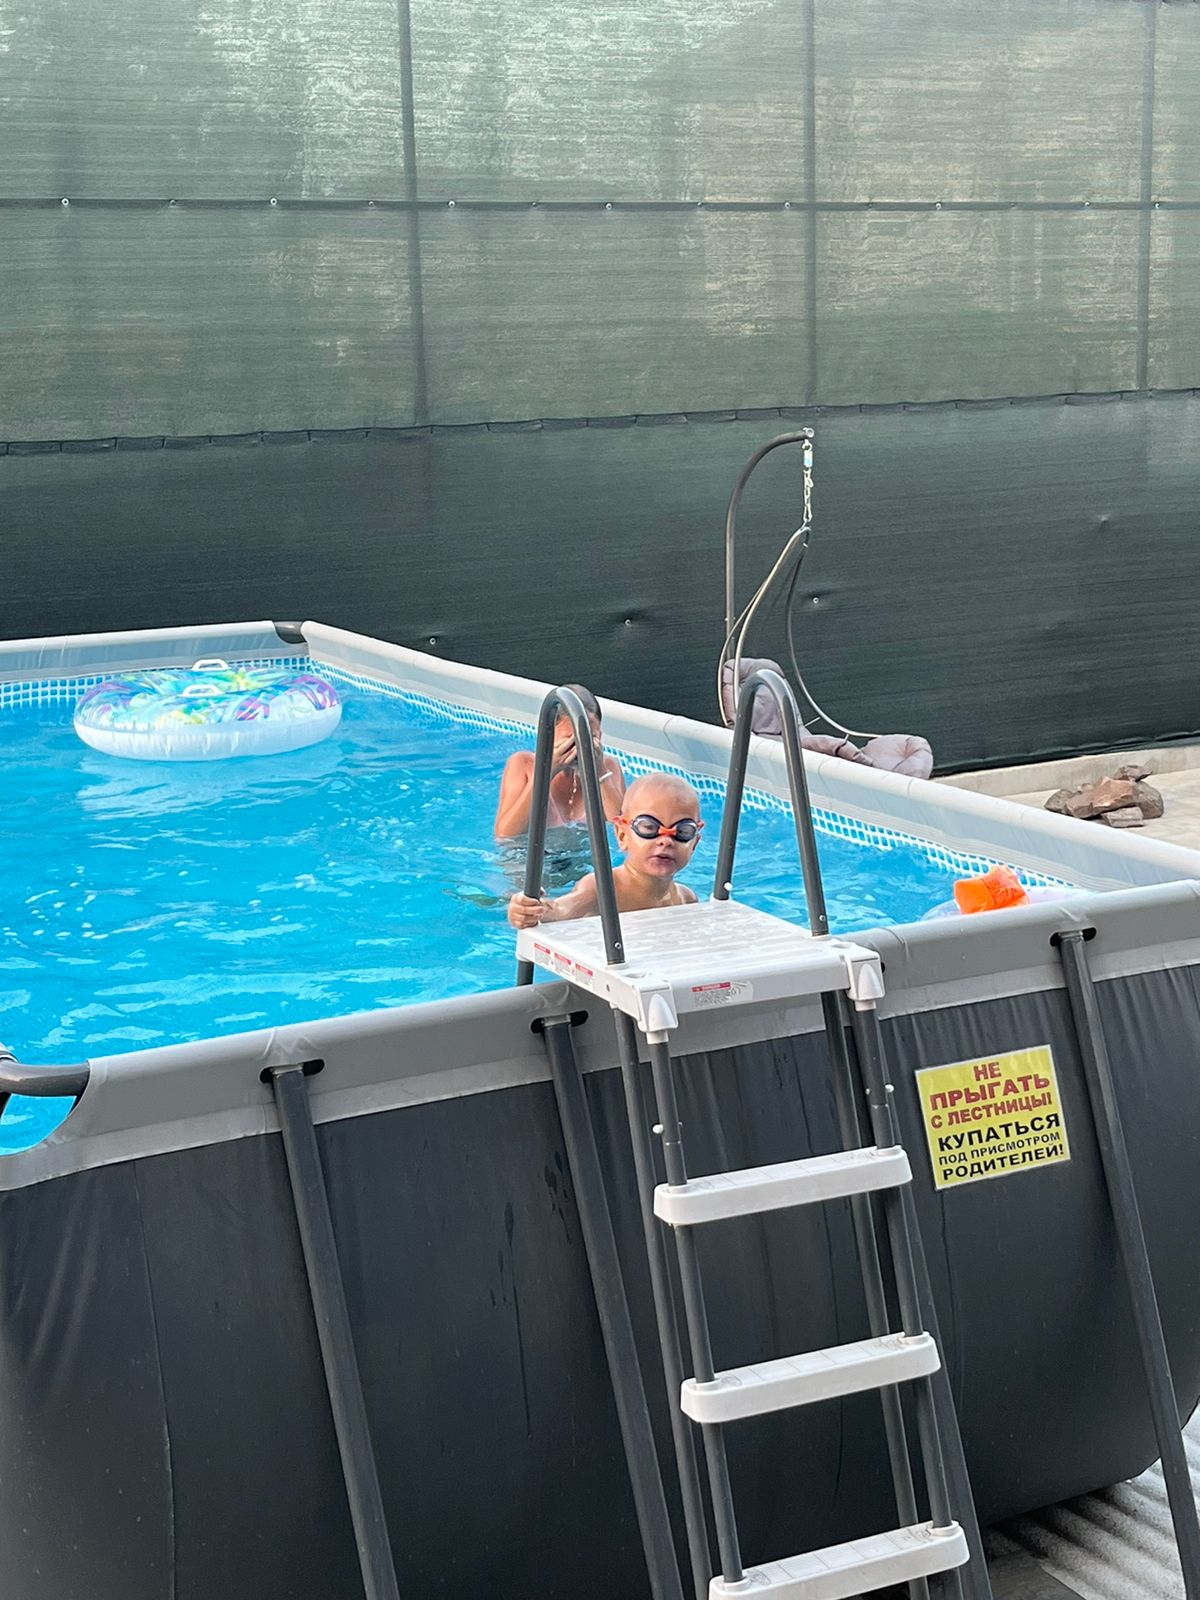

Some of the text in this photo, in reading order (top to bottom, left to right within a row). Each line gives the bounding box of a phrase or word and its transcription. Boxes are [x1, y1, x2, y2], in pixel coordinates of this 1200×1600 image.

[973, 1062, 1002, 1081] НЕ
[930, 1074, 1050, 1110] ПРЫГАТЬ
[931, 1092, 1052, 1129] С ЛЕСТНИЦЫ!
[938, 1113, 1060, 1151] КУПАТЬСЯ
[939, 1132, 1060, 1166] ПОД ПРИСМОТРОМ
[943, 1143, 1064, 1180] РОДИТЕЛЕЙ!
